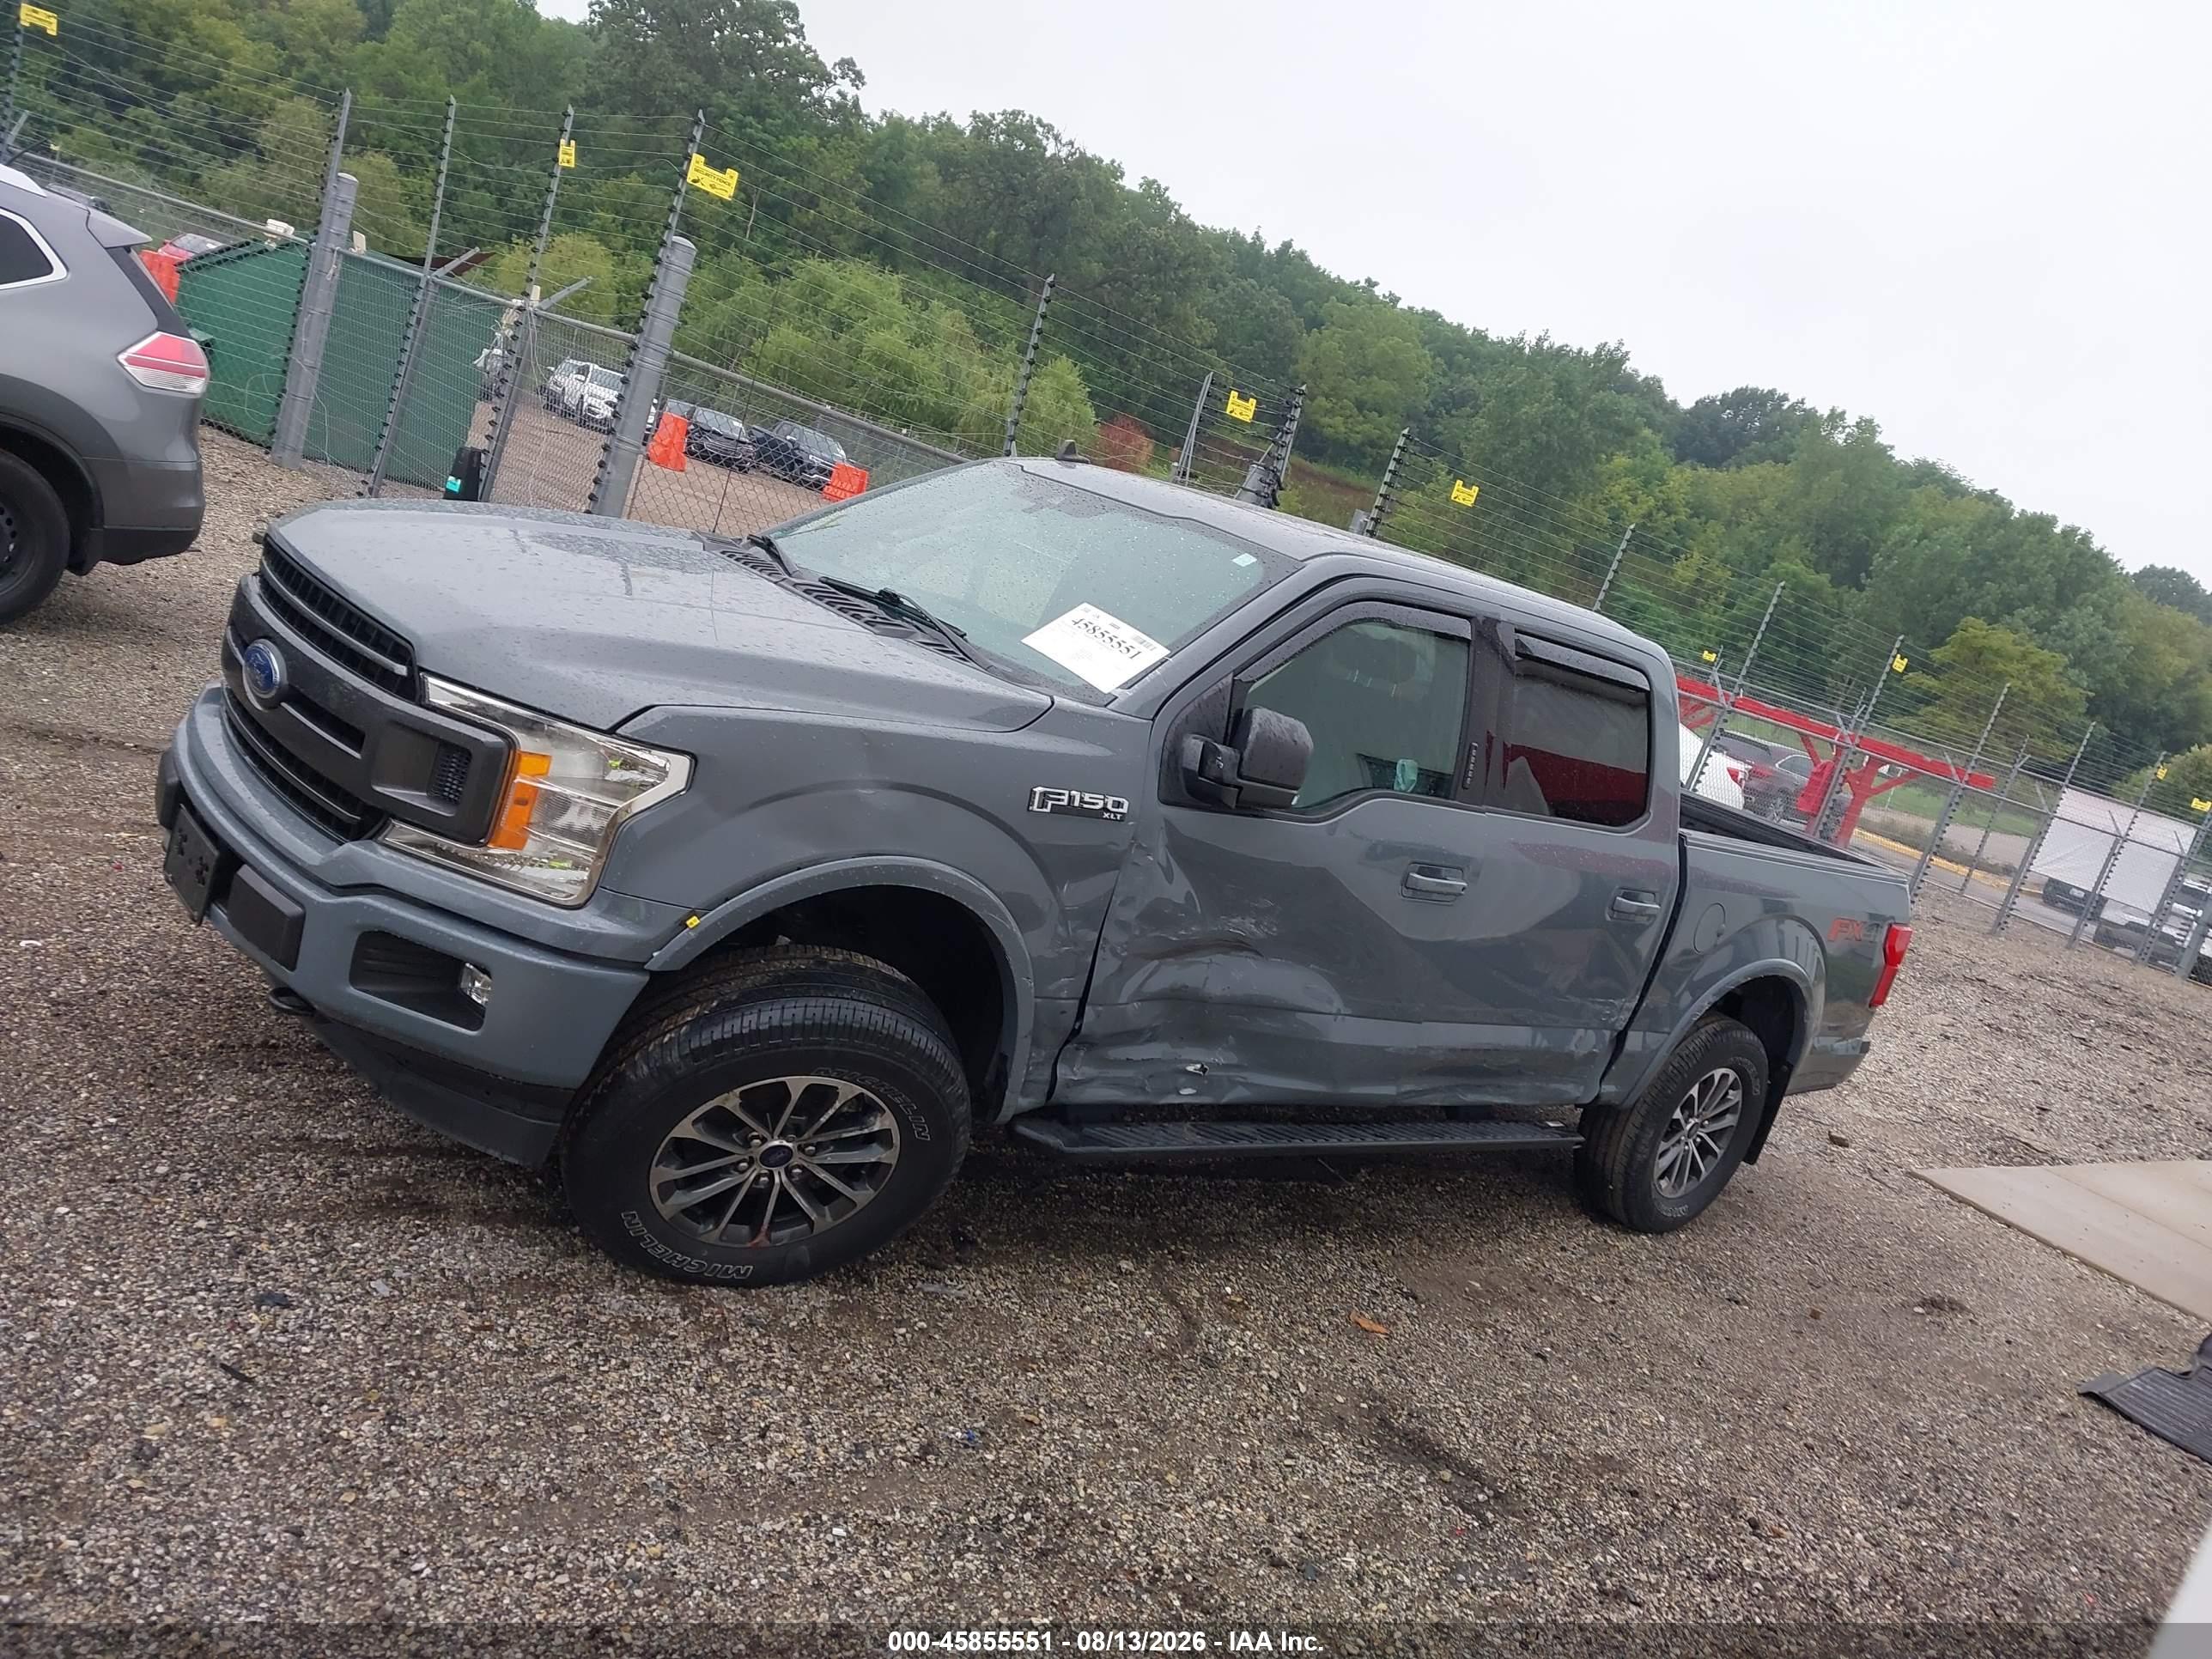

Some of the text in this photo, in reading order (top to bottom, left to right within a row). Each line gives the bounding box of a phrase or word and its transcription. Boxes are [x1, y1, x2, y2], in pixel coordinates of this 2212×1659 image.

[1071, 618, 1142, 659] 45855551
[1030, 786, 1130, 814] F150
[1103, 811, 1123, 821] XLT
[1827, 916, 1883, 943] FX4
[621, 1211, 754, 1279] MICHELIN
